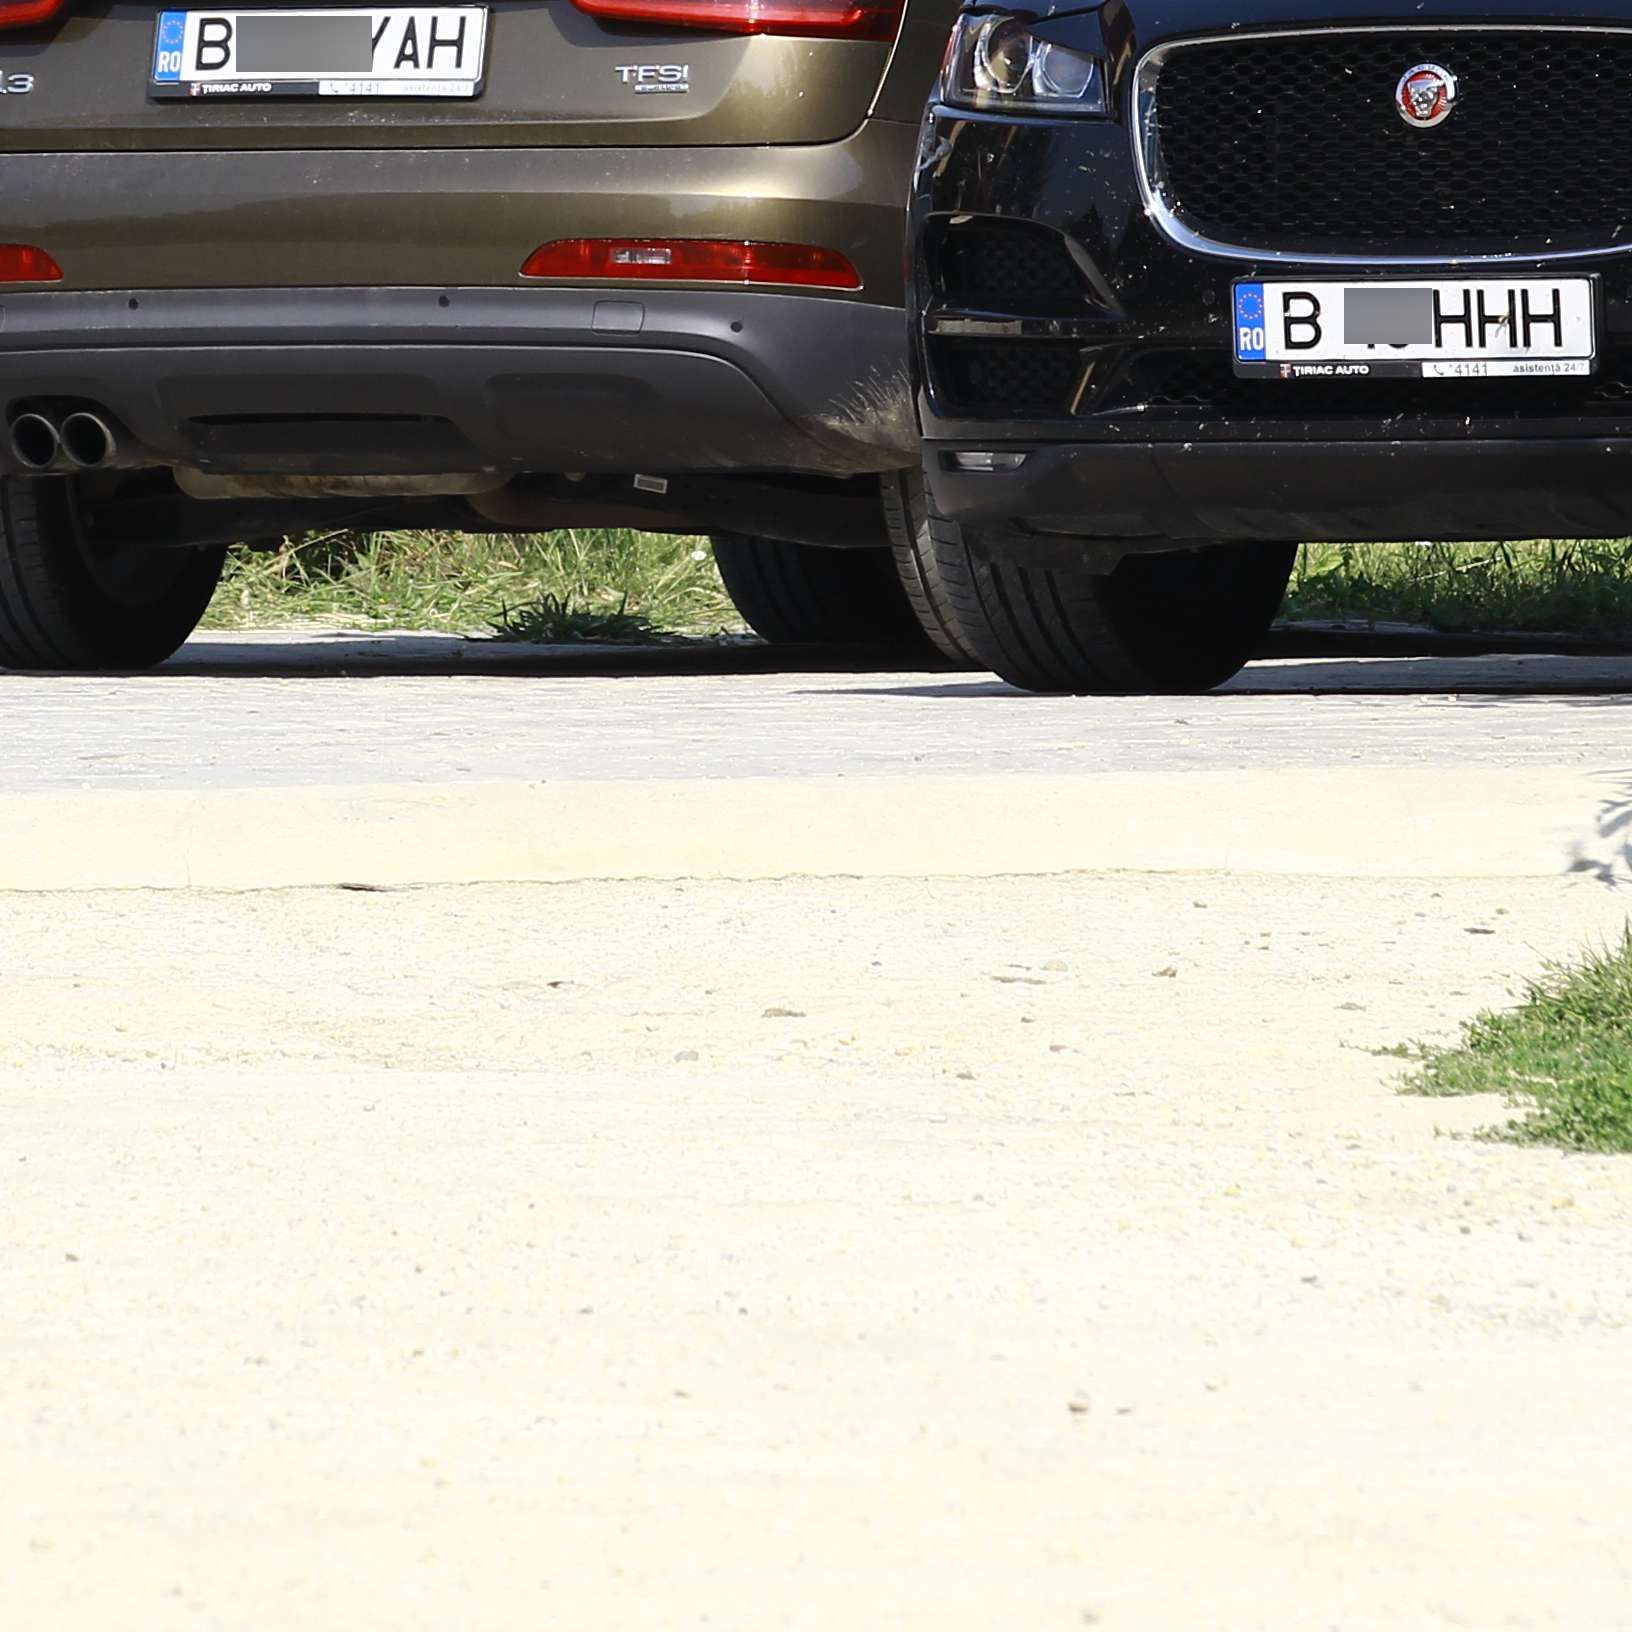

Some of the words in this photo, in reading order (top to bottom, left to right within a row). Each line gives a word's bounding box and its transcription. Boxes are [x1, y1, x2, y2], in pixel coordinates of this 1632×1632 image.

[195, 17, 233, 71] B
[158, 51, 181, 72] RO
[614, 64, 689, 83] TFSI
[239, 82, 272, 93] AUTO
[1282, 291, 1322, 350] B
[1433, 288, 1563, 348] HHH
[1240, 327, 1264, 351] RO
[1335, 364, 1370, 375] AUTO
[1563, 362, 1584, 372] 24/7
